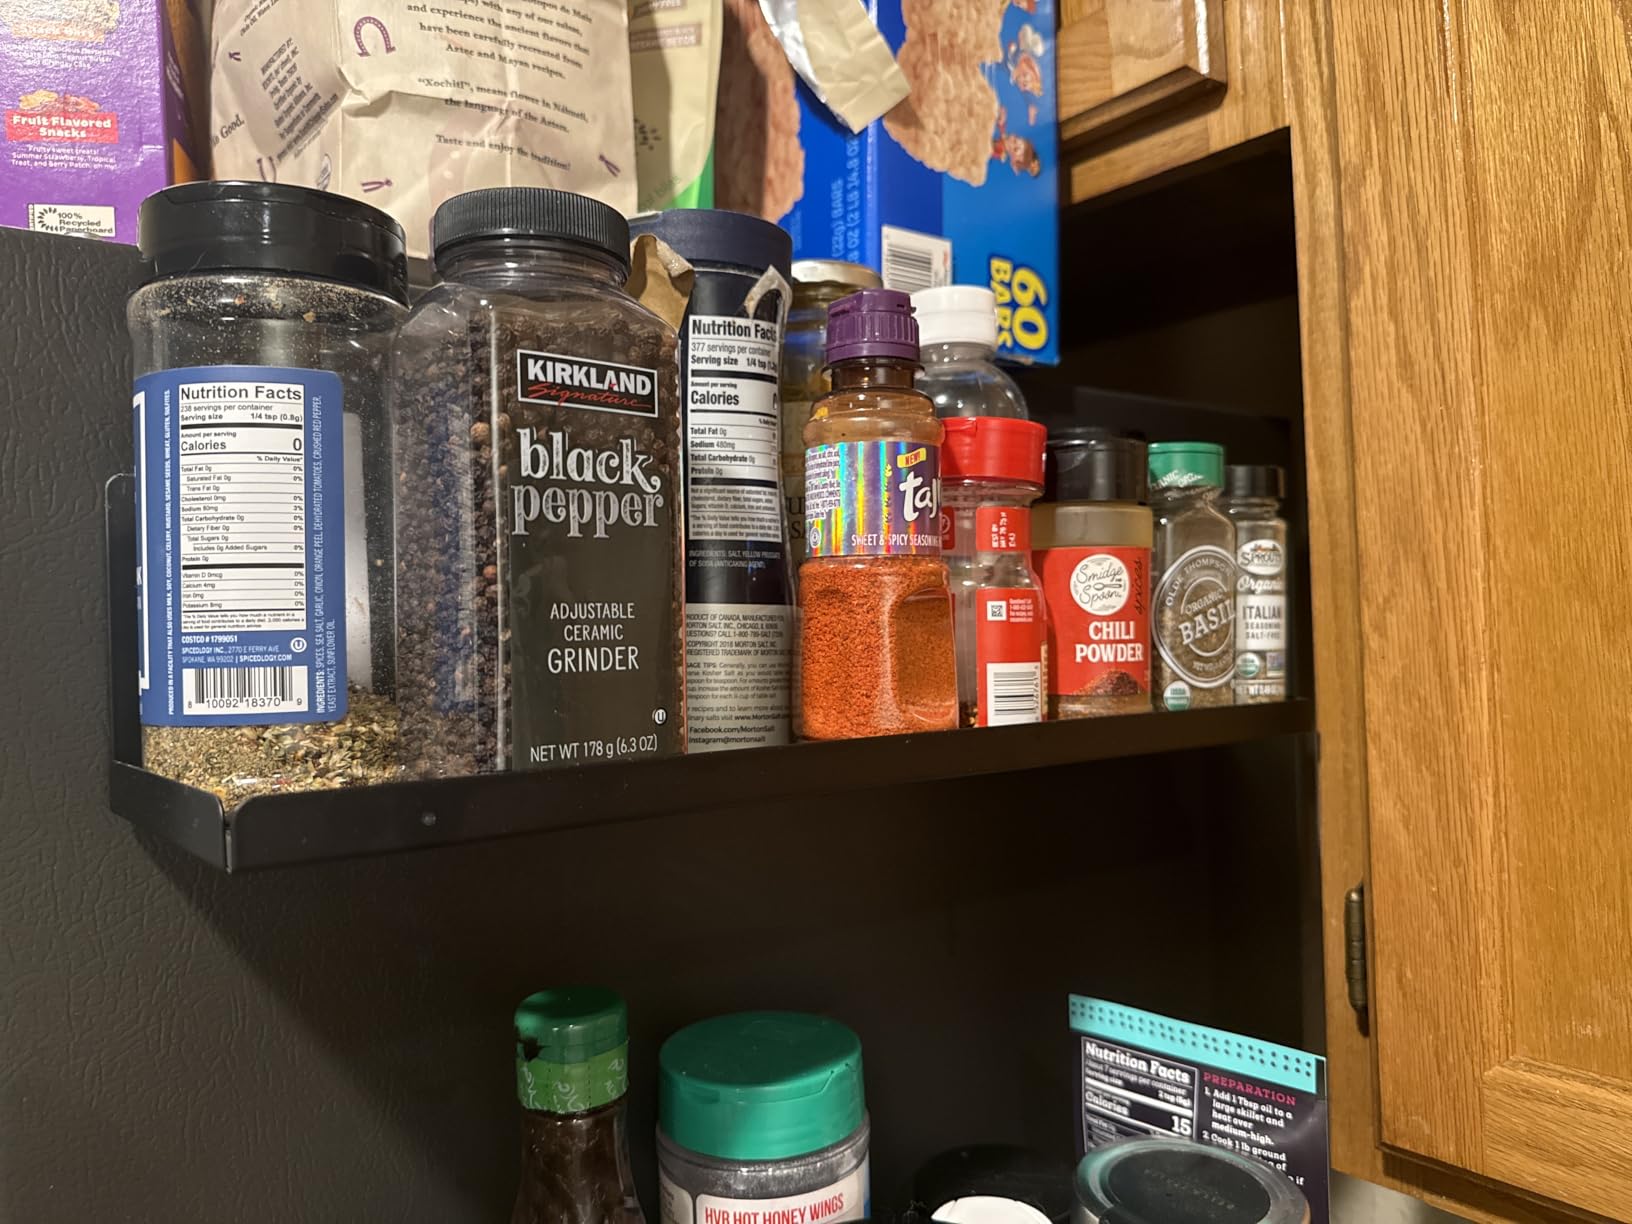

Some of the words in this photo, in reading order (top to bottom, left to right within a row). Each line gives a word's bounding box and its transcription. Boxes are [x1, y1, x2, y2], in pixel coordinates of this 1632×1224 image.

[479, 0, 503, 13] with
[506, 8, 522, 19] any
[525, 12, 535, 21] of
[537, 16, 554, 26] our
[407, 3, 427, 13] and
[430, 7, 485, 24] experience
[487, 18, 502, 28] the
[504, 23, 540, 39] ancient
[542, 32, 572, 47] flavors
[574, 41, 590, 55] that
[419, 22, 443, 33] have
[445, 25, 471, 38] been
[473, 31, 515, 50] carefully
[518, 42, 560, 61] recreated
[562, 54, 583, 69] from
[446, 43, 474, 58] Aztec
[477, 50, 496, 60] and
[498, 54, 529, 70] Mayan
[532, 62, 567, 80] recipes.
[476, 86, 508, 98] means
[510, 90, 540, 106] flower
[542, 98, 551, 110] in
[12, 115, 49, 126] Fruit
[51, 116, 112, 128] Flavored
[220, 114, 246, 139] Good.
[444, 98, 463, 108] the
[464, 99, 508, 116] language
[511, 109, 523, 118] of
[524, 112, 538, 123] the
[541, 116, 570, 133] Aztecs.
[38, 127, 87, 138] Snacks
[435, 134, 463, 146] Taste
[465, 138, 485, 149] and
[488, 141, 515, 156] enjoy
[516, 146, 529, 157] the
[531, 151, 571, 171] tradition!
[846, 158, 860, 190] 14.8
[831, 178, 844, 219] BARS
[846, 190, 860, 209] LB
[57, 212, 83, 220] 100%
[59, 219, 101, 227] Recycled
[846, 211, 861, 228] (2
[59, 226, 113, 234] Paperboard
[831, 221, 846, 259] (22g)
[846, 228, 860, 250] OZ
[990, 257, 1013, 349] BARS
[1011, 267, 1048, 350] 60
[692, 319, 751, 338] Nutrition
[754, 323, 777, 343] Facts
[691, 342, 706, 352] 377
[707, 343, 736, 355] servings
[737, 346, 748, 355] per
[690, 354, 721, 366] Serving
[723, 355, 738, 366] size
[746, 356, 757, 367] 1/4
[527, 358, 652, 396] KIRKLAND
[181, 385, 249, 400] Nutrition
[254, 386, 302, 400] Facts
[527, 382, 652, 407] Signature
[691, 390, 740, 405] Calories
[180, 404, 193, 413] 238
[193, 404, 222, 412] servings
[223, 405, 236, 413] per
[180, 413, 206, 421] Serving
[208, 412, 223, 420] size
[250, 412, 263, 420] 1/4
[264, 413, 278, 421] tsp
[280, 414, 303, 423] (0.8g)
[312, 420, 322, 431] RED
[690, 427, 707, 435] Total
[708, 427, 718, 435] Fat
[181, 440, 227, 451] Calories
[292, 437, 303, 451] 0
[312, 433, 322, 459] CRUSHED
[690, 440, 715, 448] Sodium
[716, 441, 736, 450] 480mg
[516, 426, 661, 494] black
[690, 453, 707, 462] Total
[708, 453, 748, 463] Carbohydrate
[905, 450, 922, 466] NEW!
[690, 467, 714, 475] Protein
[510, 484, 664, 539] pepper
[851, 533, 877, 546] SWEET
[879, 534, 885, 546] &
[888, 534, 909, 546] SPICY
[1076, 562, 1124, 585] Smidge
[1165, 575, 1185, 607] OLDE
[1183, 557, 1234, 578] THOMPSON
[1079, 584, 1122, 608] Spoon
[1184, 588, 1225, 616] ORGANIC
[550, 602, 636, 620] ADJUSTABLE
[1178, 599, 1237, 645] BASIL
[1243, 605, 1281, 620] ITALIAN
[181, 635, 205, 644] COSTCO
[211, 635, 238, 643] 1799051
[563, 624, 624, 642] CERAMIC
[1088, 620, 1135, 641] CHILI
[181, 646, 212, 654] SPICEOLOGY
[239, 654, 293, 662] SPICEOLOGY.COM
[327, 631, 336, 665] SUNFLOWER
[1075, 642, 1144, 663] POWDER
[547, 646, 640, 674] GRINDER
[316, 669, 325, 713] INGREDIENTS:
[206, 698, 239, 708] 10092
[245, 697, 281, 707] 18370
[296, 698, 302, 706] 9
[327, 693, 336, 712] YEAST
[689, 725, 775, 734] Facebook.com/MortonSalt
[530, 744, 557, 763] NET
[559, 742, 580, 760] WT
[583, 740, 604, 757] 178
[606, 742, 614, 759] g
[616, 736, 637, 756] (6.3
[639, 733, 658, 752] OZ)
[1086, 1041, 1149, 1073] Nutrition
[1150, 1060, 1191, 1084] Facts
[1203, 1072, 1296, 1106] PREPARATION
[1086, 1091, 1129, 1116] Calories
[1204, 1086, 1211, 1096] 1.
[1213, 1089, 1230, 1101] Add
[1231, 1094, 1237, 1103] 1
[1237, 1095, 1259, 1111] Tbsp
[1261, 1104, 1273, 1114] oil
[1274, 1107, 1285, 1117] to
[1285, 1111, 1294, 1120] a
[1212, 1099, 1236, 1113] large
[1236, 1105, 1265, 1122] skillet
[1266, 1116, 1285, 1128] and
[1171, 1115, 1192, 1137] 15
[1212, 1109, 1232, 1122] heat
[1233, 1117, 1254, 1129] over
[1211, 1121, 1275, 1146] medium-high.
[1211, 1133, 1234, 1147] Cook
[1235, 1140, 1240, 1149] 1
[1241, 1141, 1251, 1151] lb
[1252, 1146, 1287, 1162] ground
[1276, 1162, 1288, 1172] of
[1295, 1175, 1305, 1186] if
[705, 1206, 730, 1224] HVR
[733, 1212, 759, 1224] HOT
[763, 1207, 807, 1224] HONEY
[809, 1192, 844, 1222] WINGS
